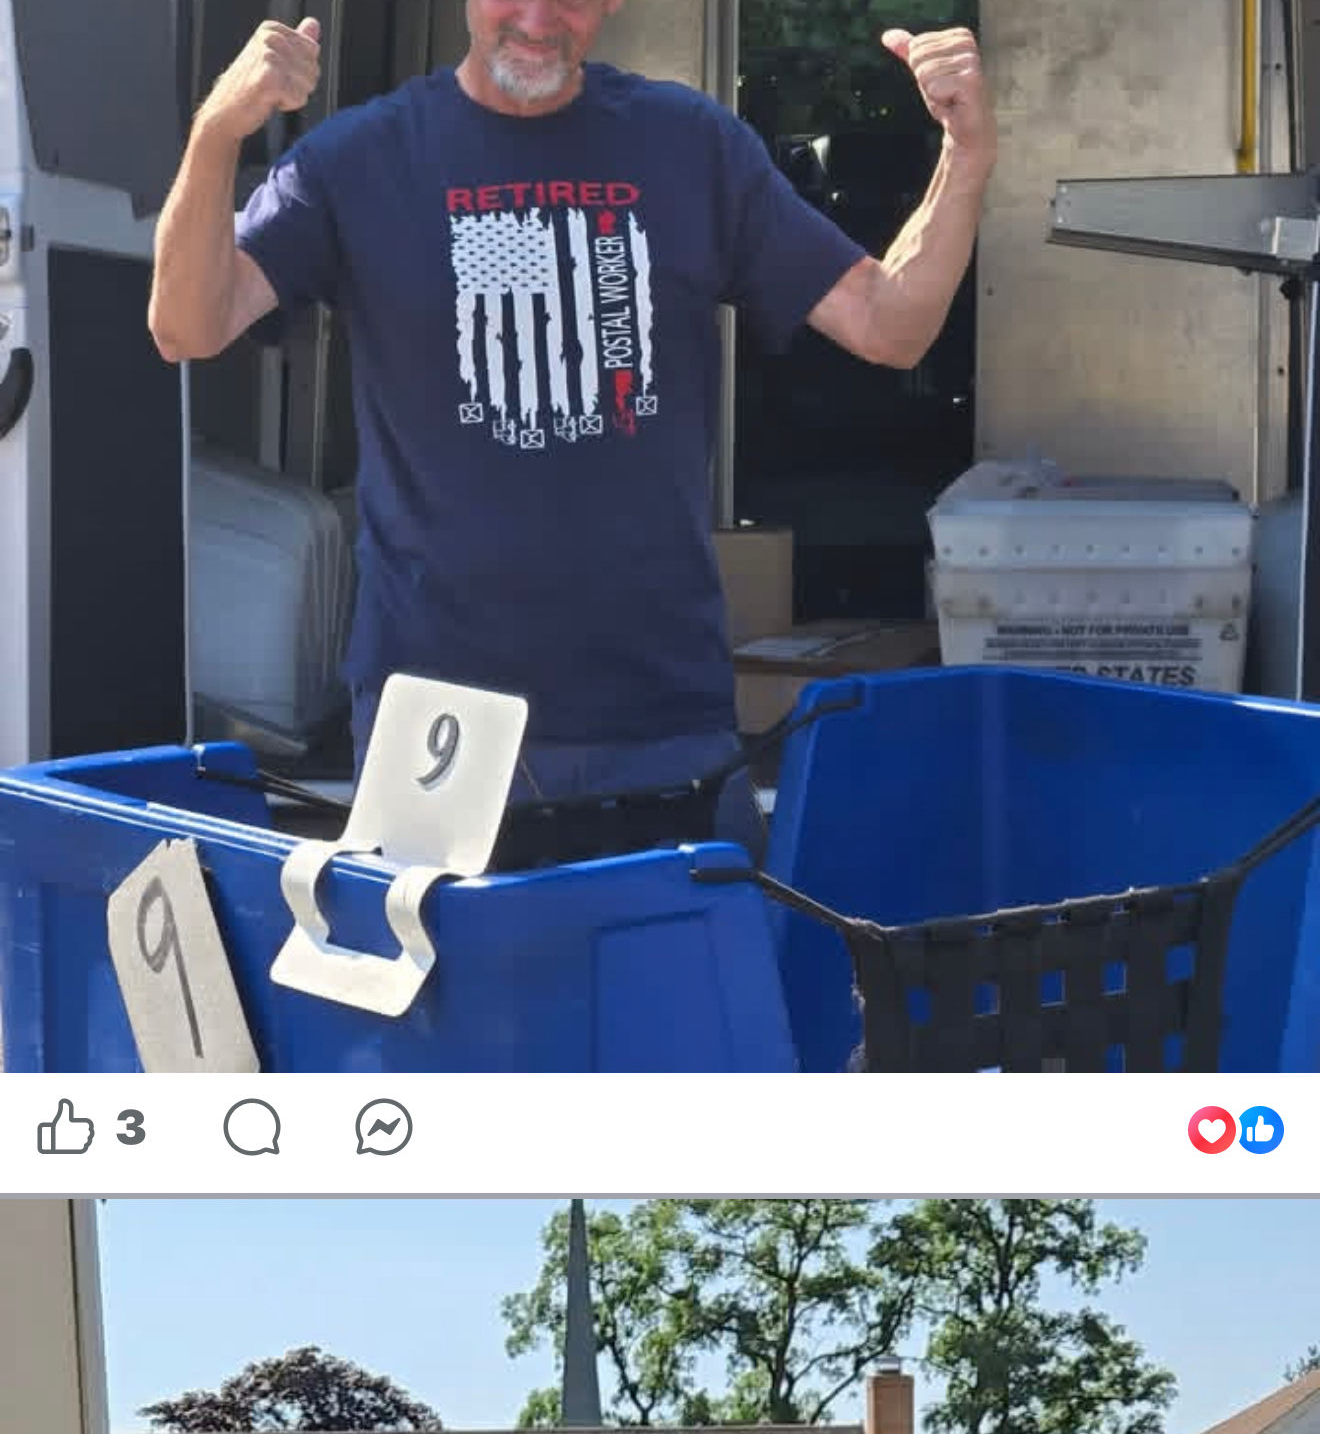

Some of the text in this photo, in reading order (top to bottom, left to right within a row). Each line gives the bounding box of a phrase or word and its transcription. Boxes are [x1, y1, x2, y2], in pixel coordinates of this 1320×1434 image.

[446, 181, 640, 212] RETIRED
[595, 235, 633, 369] POSTAL WORKER
[415, 713, 460, 785] 9
[137, 876, 204, 1059] 9
[116, 1108, 146, 1146] 3
